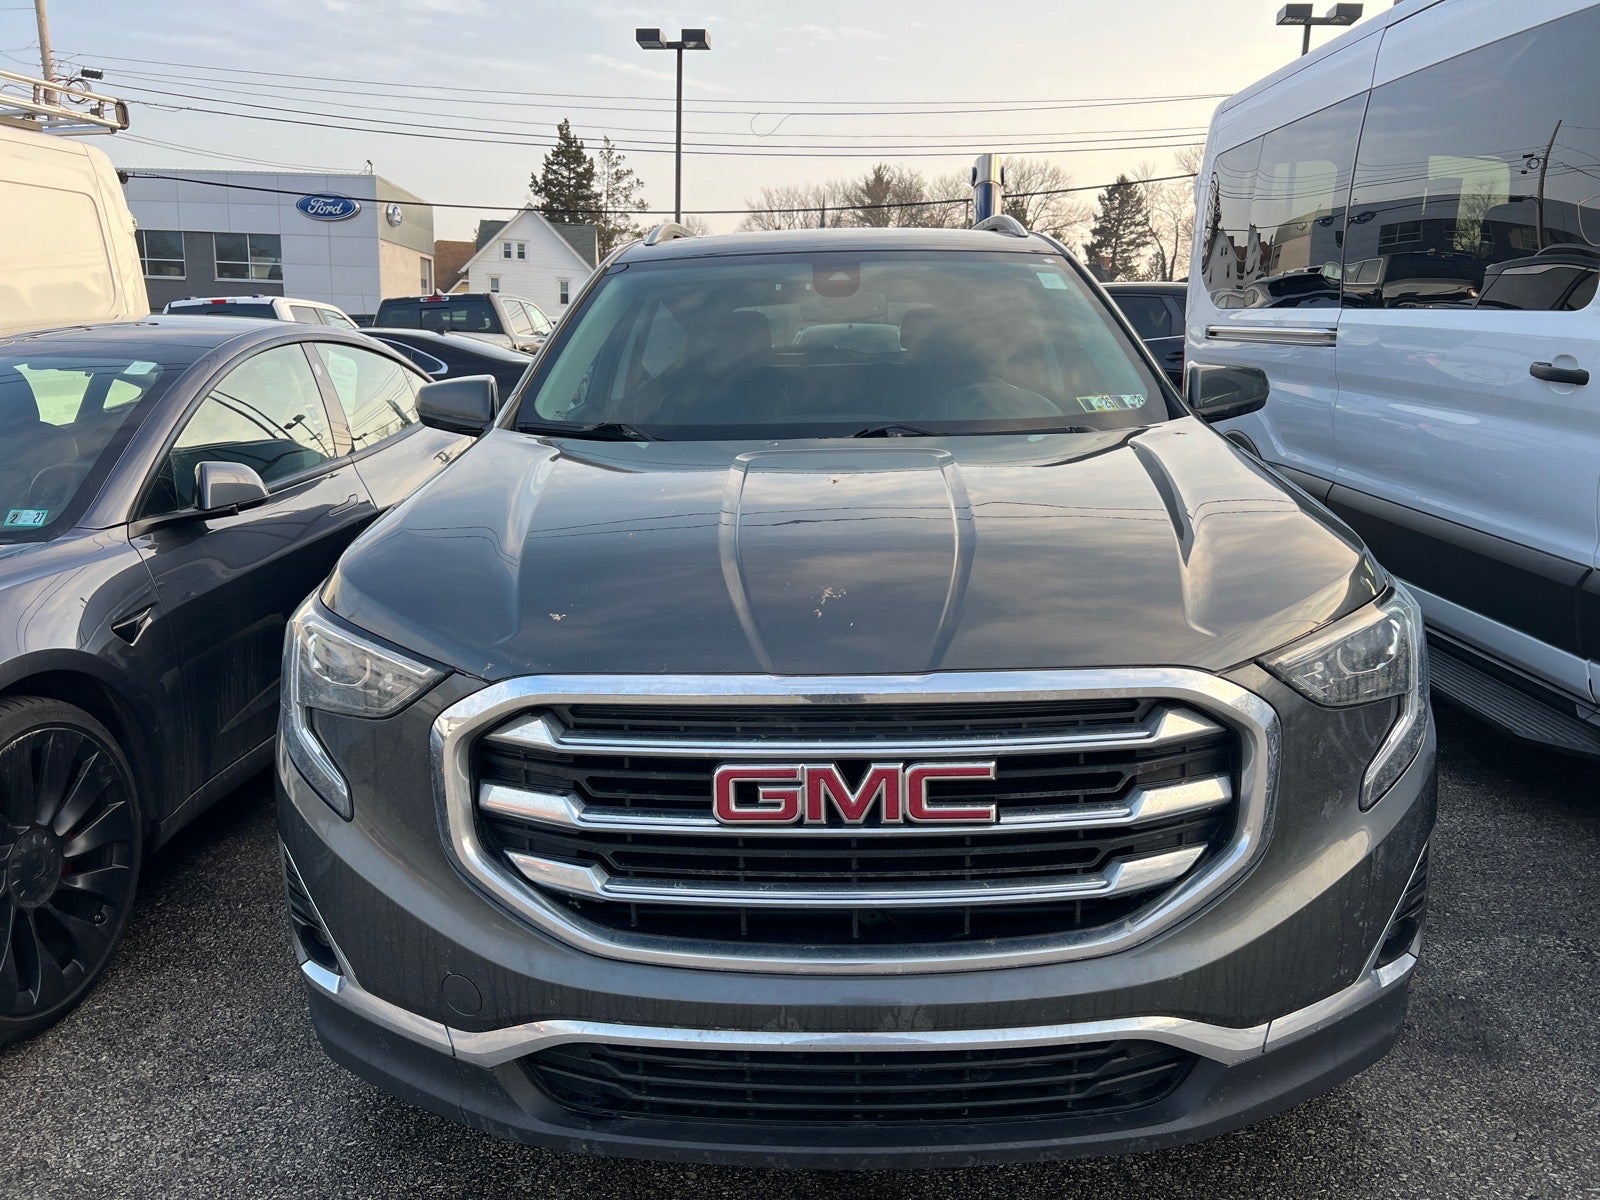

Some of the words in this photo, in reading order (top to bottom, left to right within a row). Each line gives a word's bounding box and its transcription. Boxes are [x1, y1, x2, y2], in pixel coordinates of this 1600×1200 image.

[307, 198, 343, 215] Ford
[10, 513, 19, 524] 2
[33, 512, 45, 524] 27
[712, 761, 997, 825] GMC
